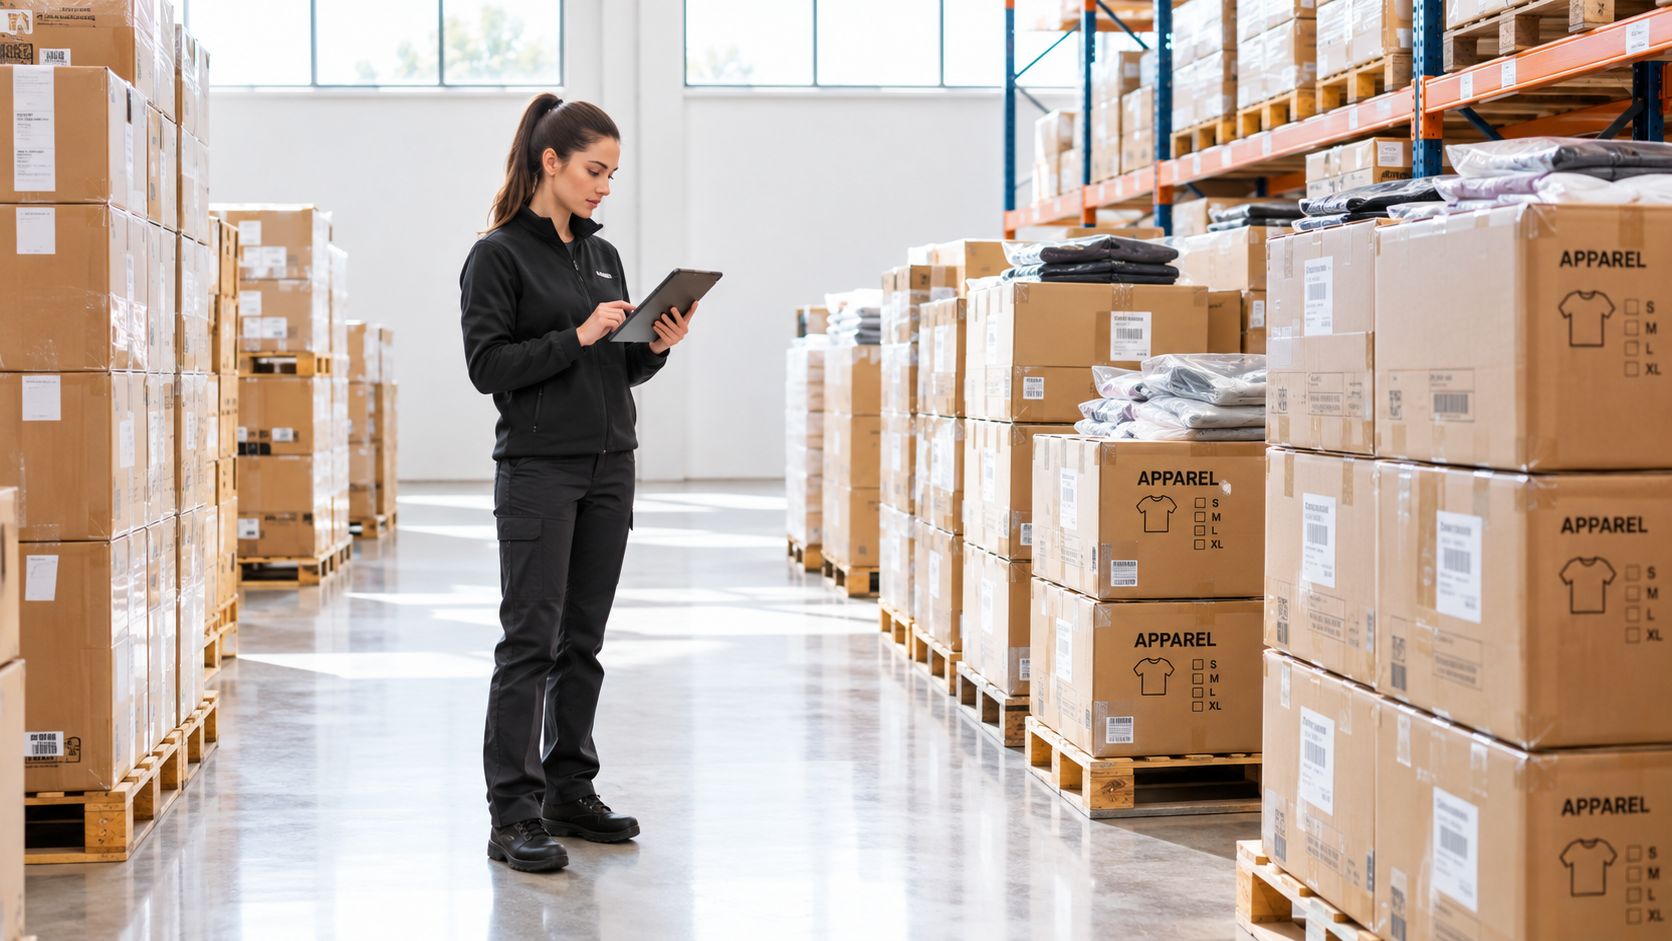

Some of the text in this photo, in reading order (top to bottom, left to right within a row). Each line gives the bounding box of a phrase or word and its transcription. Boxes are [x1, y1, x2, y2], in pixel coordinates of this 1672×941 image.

[1559, 251, 1647, 269] APPAREL
[1645, 300, 1655, 315] S
[1645, 321, 1657, 335] M
[1645, 342, 1654, 356] L
[1645, 363, 1661, 376] XL
[1137, 471, 1220, 487] APPAREL
[1212, 498, 1219, 508] S
[1211, 512, 1221, 522] M
[1211, 525, 1219, 536] L
[1560, 517, 1648, 534] APPAREL
[1210, 539, 1224, 549] XL
[1646, 565, 1657, 580] S
[1646, 586, 1659, 600] M
[1646, 607, 1656, 622] L
[1134, 632, 1217, 648] APPAREL
[1646, 629, 1663, 642] XL
[1210, 659, 1217, 670] S
[1209, 673, 1220, 684] M
[1209, 687, 1216, 697] L
[1208, 700, 1222, 711] XL
[1561, 797, 1650, 816] APPAREL
[1648, 846, 1658, 860] S
[1647, 867, 1660, 879] M
[1647, 887, 1656, 902] L
[1648, 909, 1664, 922] XL
